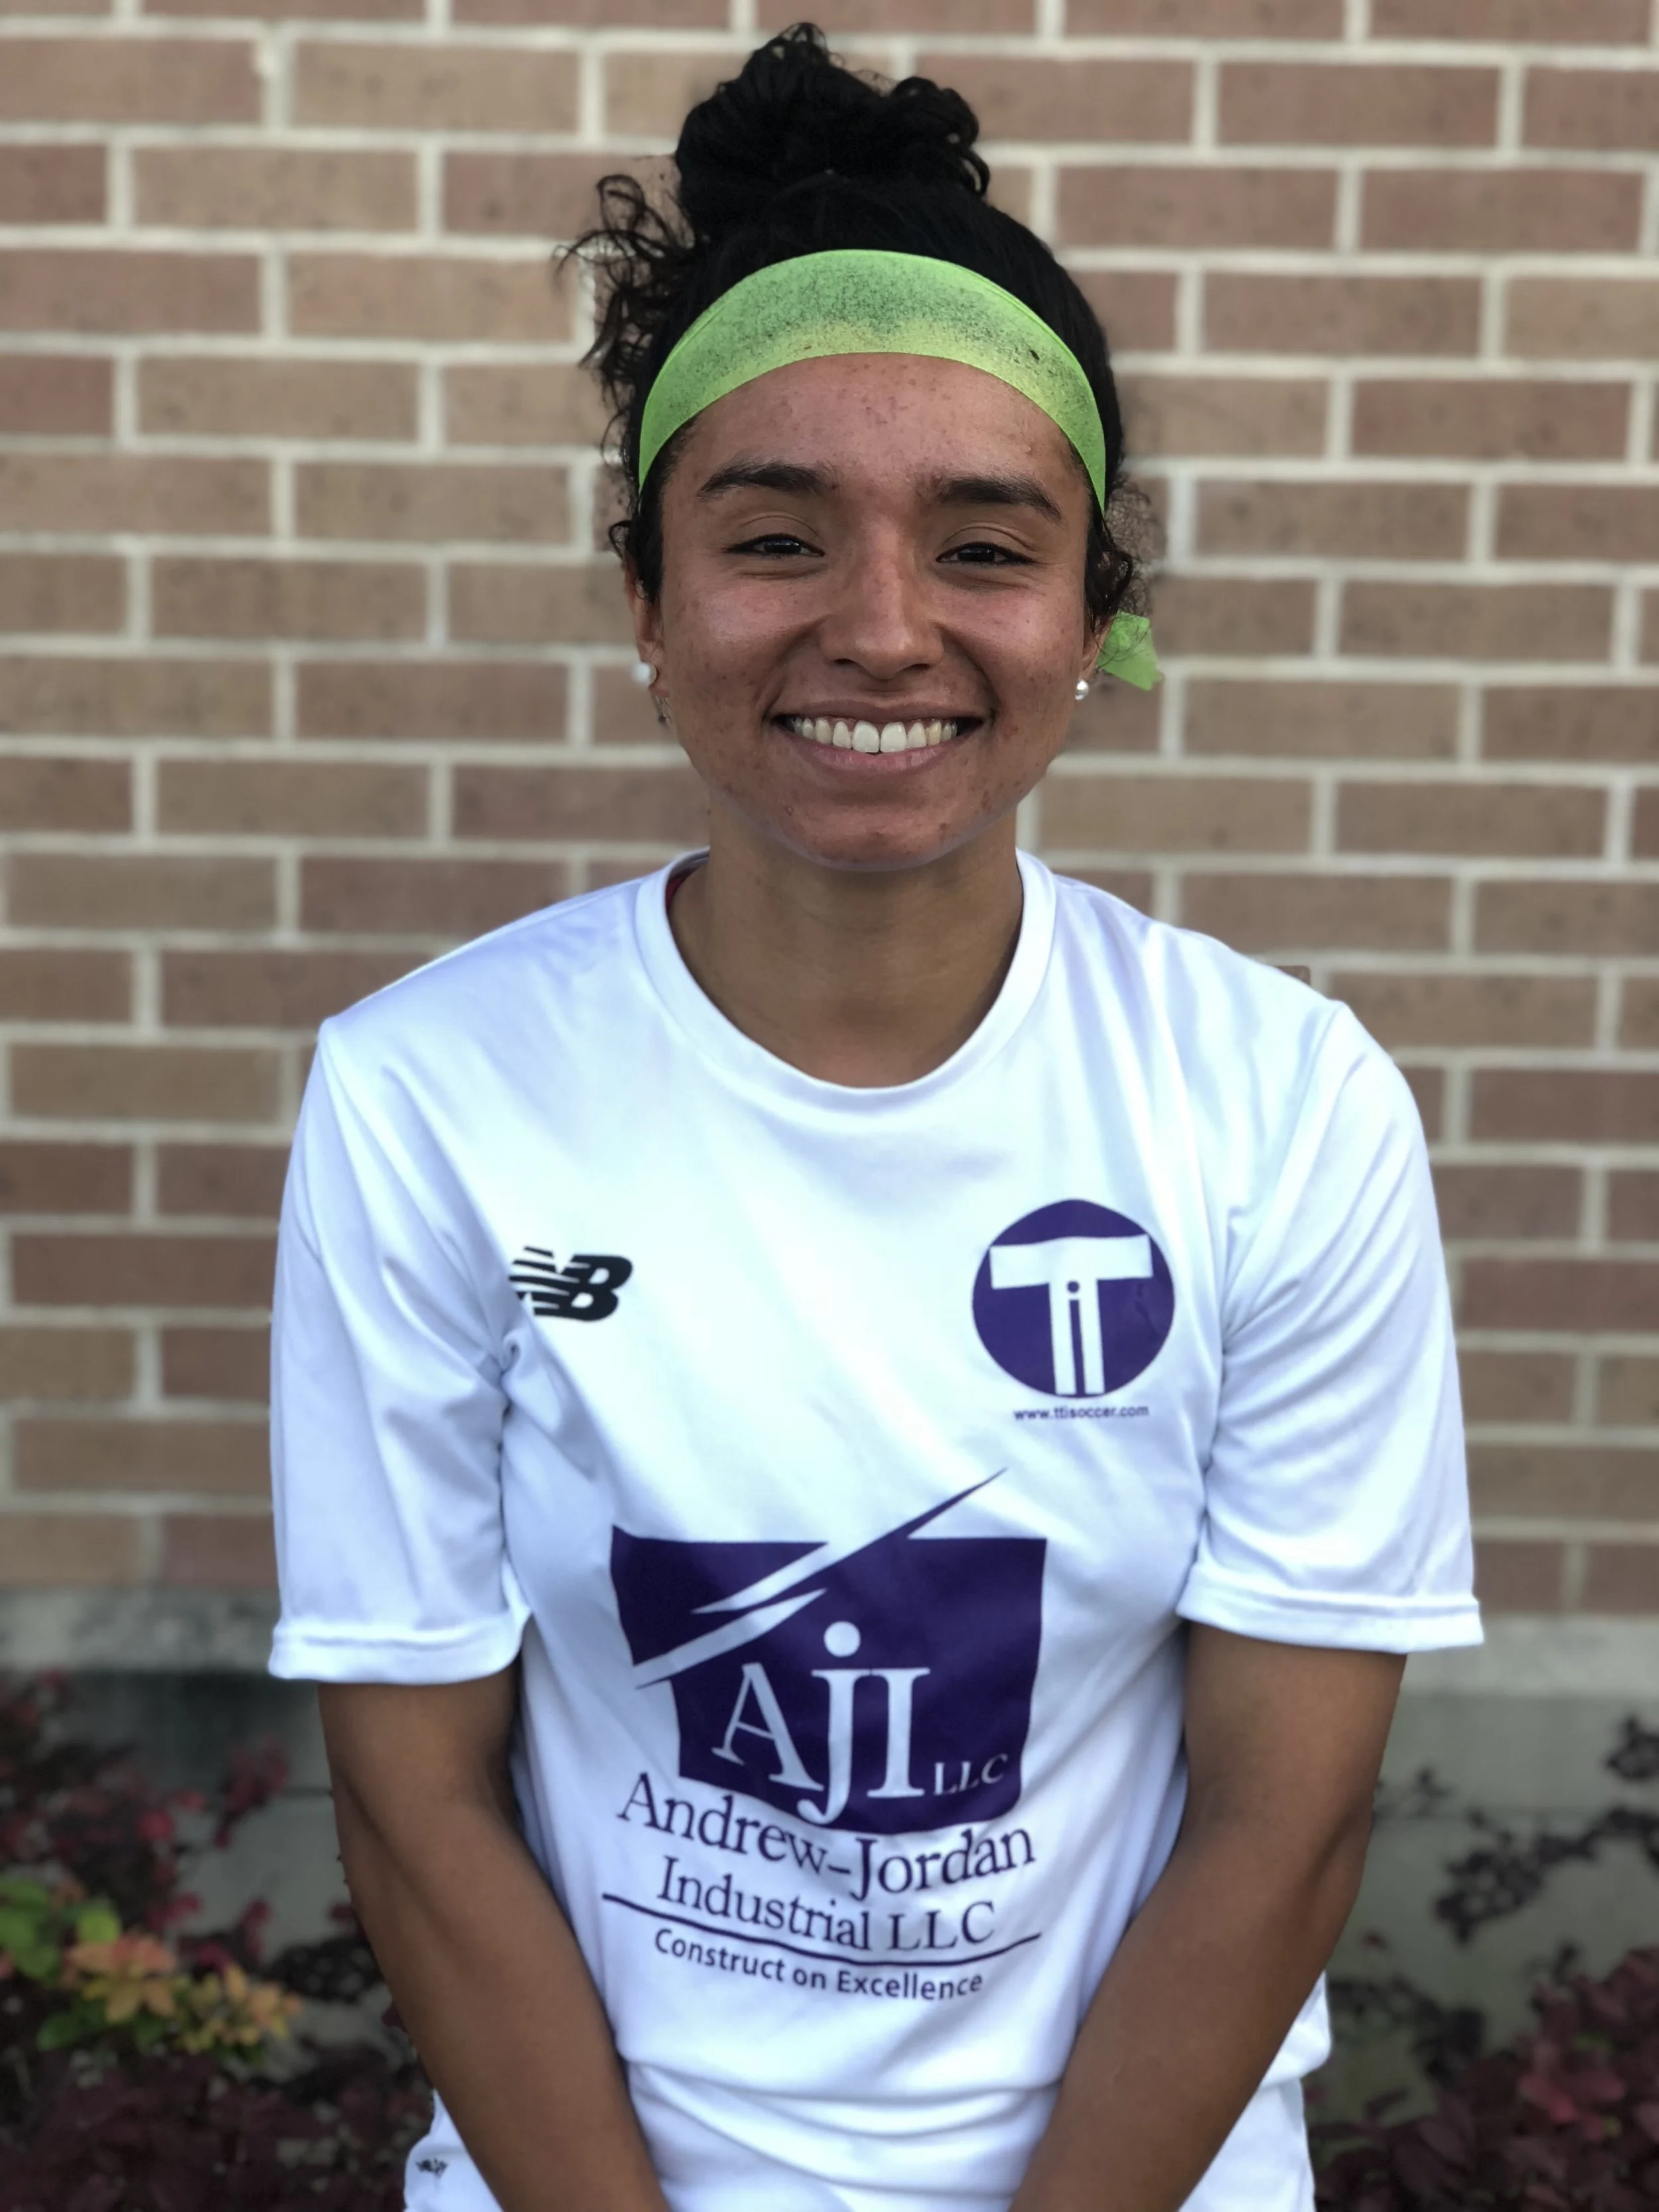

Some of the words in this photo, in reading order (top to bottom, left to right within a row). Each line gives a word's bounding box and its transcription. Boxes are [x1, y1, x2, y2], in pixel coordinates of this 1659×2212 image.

[934, 1753, 1009, 1796] LLC
[616, 1771, 1037, 1902] Andrew-Jordan
[656, 1856, 871, 1951] Industrial
[887, 1900, 995, 1951] LLC
[655, 1928, 785, 1982] Construct
[837, 1970, 983, 2001] Excellence
